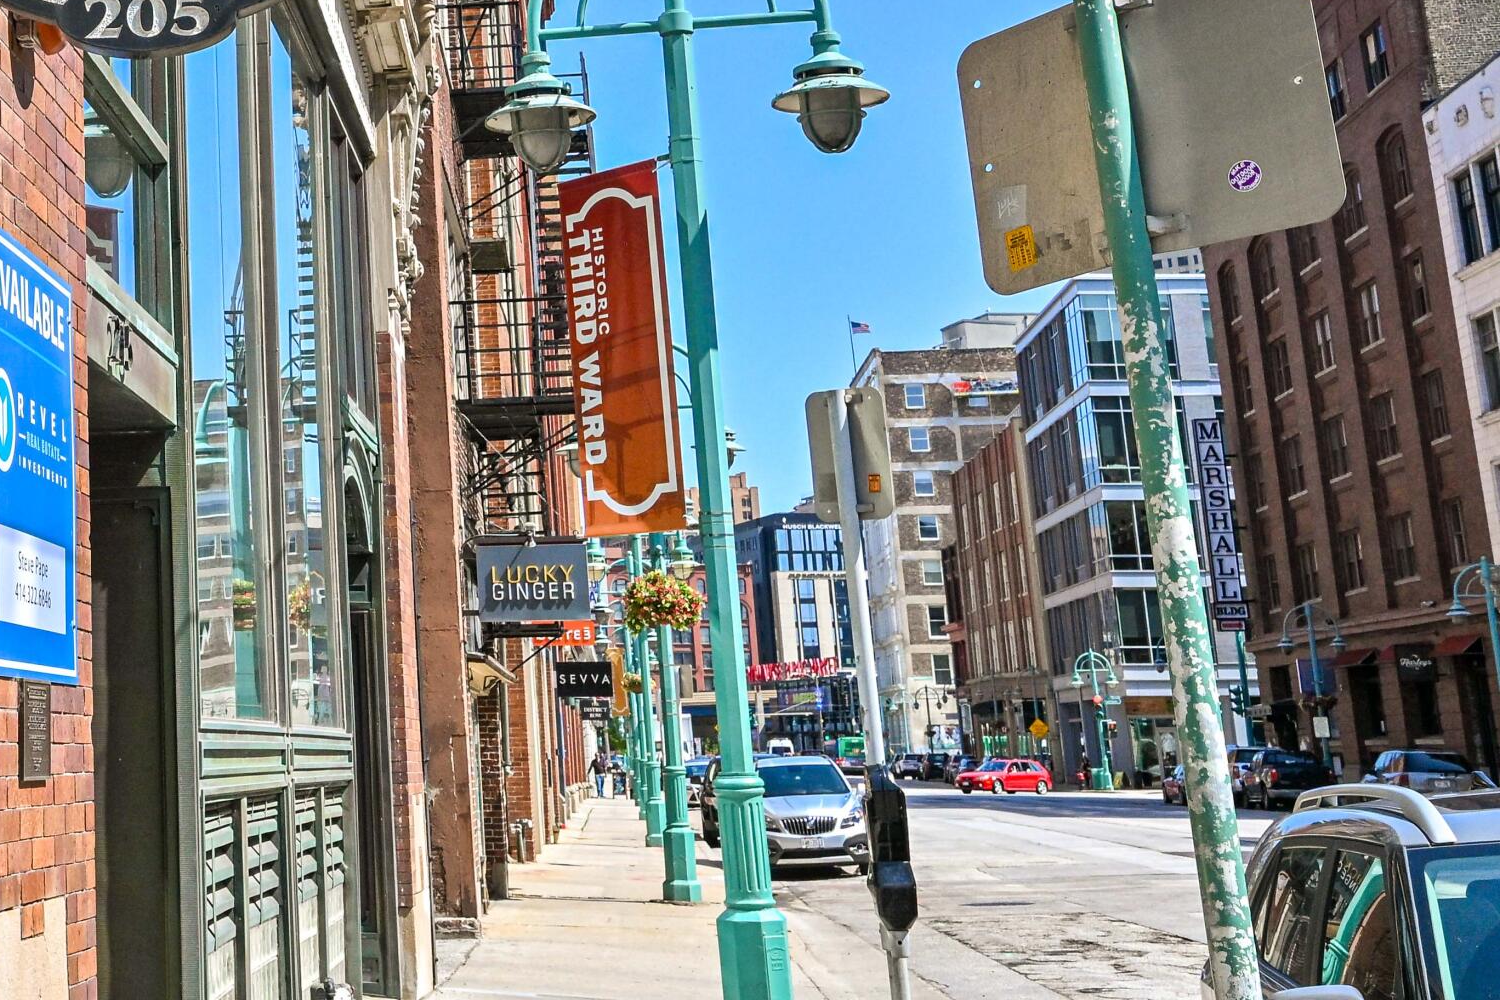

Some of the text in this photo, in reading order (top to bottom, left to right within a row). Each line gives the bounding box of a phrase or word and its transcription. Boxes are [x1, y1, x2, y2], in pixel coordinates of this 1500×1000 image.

[592, 227, 610, 335] HISTORIC
[568, 229, 608, 465] THIRD WARD
[17, 392, 67, 443] REVEL
[26, 431, 60, 462] REAL ESTATE
[18, 454, 67, 489] INVESTMENTS
[1199, 422, 1238, 600] MARSHALL
[18, 551, 49, 581] Steve Pape
[491, 563, 574, 584] LUCKY
[492, 582, 575, 601] GINGER
[1216, 606, 1246, 617] BLDG
[559, 673, 611, 685] SEVVA
